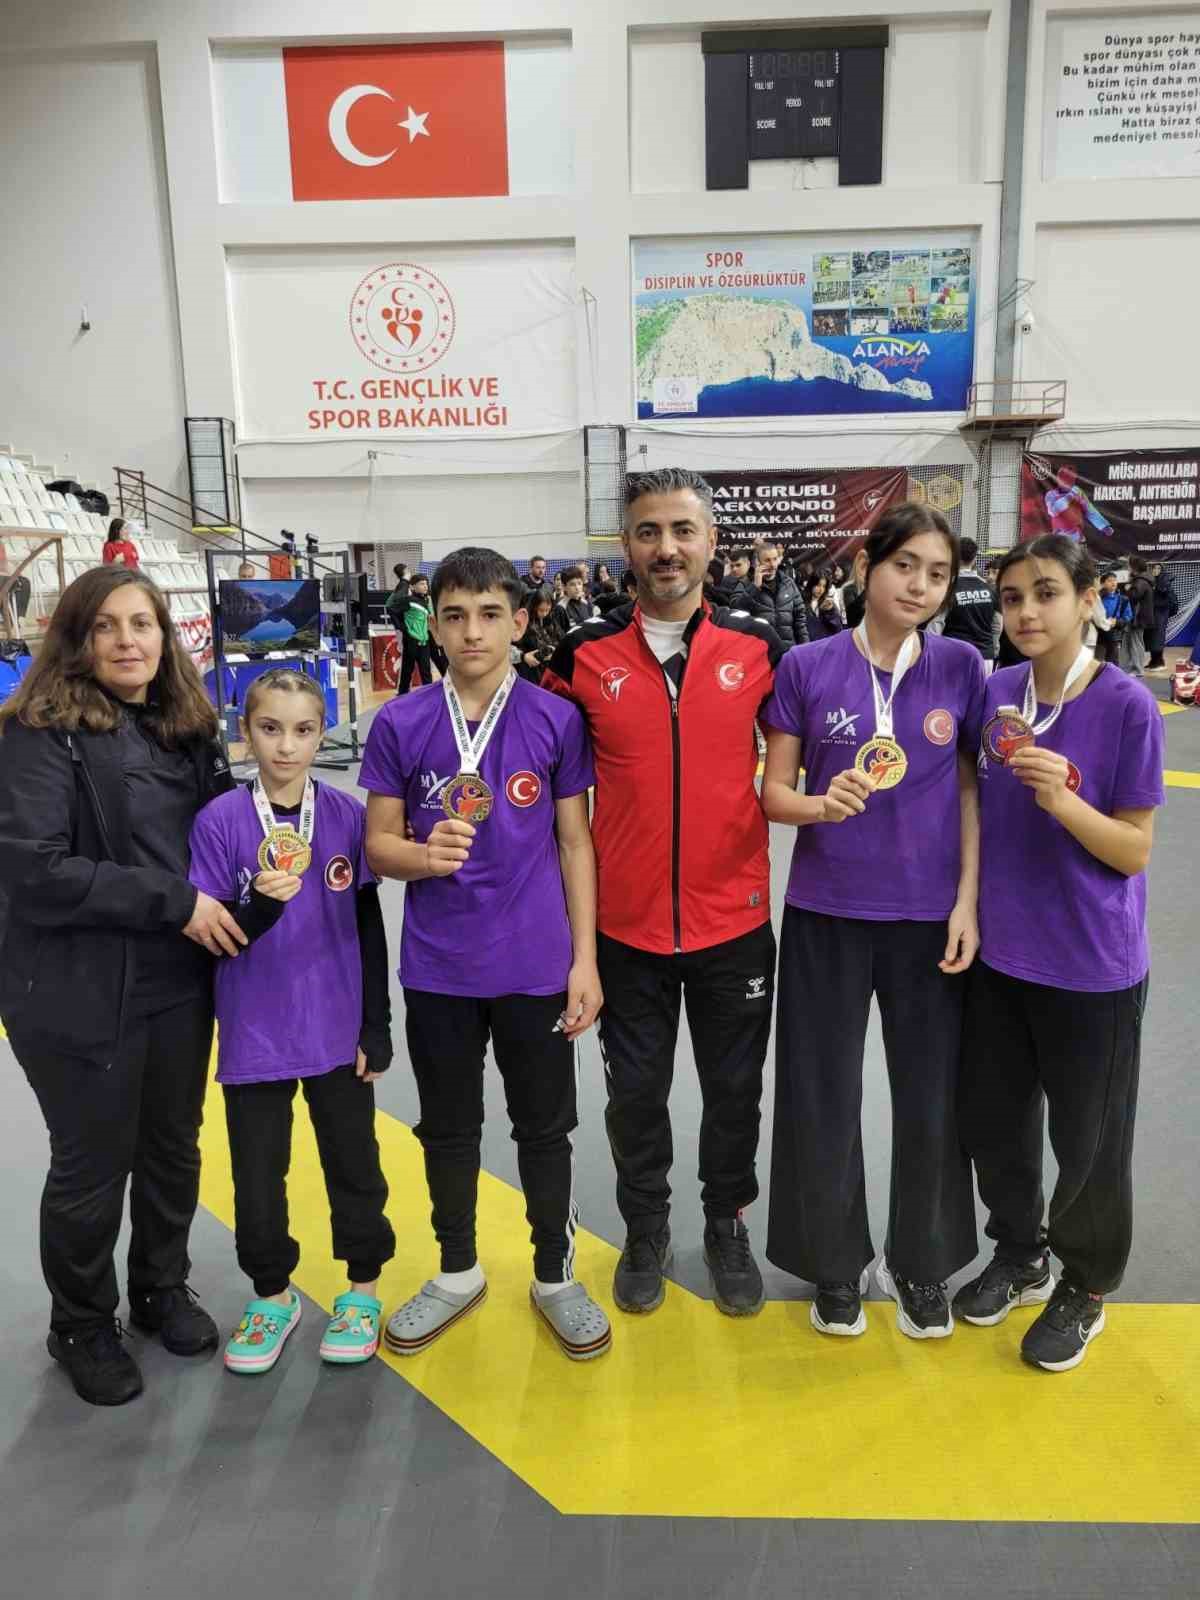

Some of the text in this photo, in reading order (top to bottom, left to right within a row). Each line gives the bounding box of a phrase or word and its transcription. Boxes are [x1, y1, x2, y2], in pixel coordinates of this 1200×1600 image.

[1147, 35, 1174, 46] spor
[1084, 52, 1110, 62] spor
[1063, 66, 1078, 76] Bu
[1084, 64, 1119, 75] kadar
[1169, 60, 1196, 71] olan
[1088, 79, 1120, 88] bizim
[1152, 75, 1182, 85] daha
[1128, 107, 1141, 115] ve
[756, 119, 776, 129] SCORE
[812, 117, 832, 127] SCORE
[1121, 118, 1155, 128] Hatta
[1160, 115, 1190, 126] biraz
[1093, 131, 1157, 143] medeniyet
[706, 251, 743, 268] SPOR
[700, 275, 713, 288] VE
[852, 340, 931, 358] ALANYA
[313, 374, 499, 404] T.C. GENÇLİK VE
[308, 402, 508, 429] SPOR BAKANLIĞI
[1109, 462, 1198, 480] MÜSABAKALARA
[709, 484, 836, 498] ATI GRUBU
[1093, 482, 1197, 502] HAKEM, ANTRENÖR
[711, 500, 836, 513] AEKWONDO
[712, 513, 835, 525] ÜSABAKALARI
[1133, 504, 1193, 524] BAŞARILAR
[729, 527, 870, 539] YILDIZLAR BÜYÜKLER
